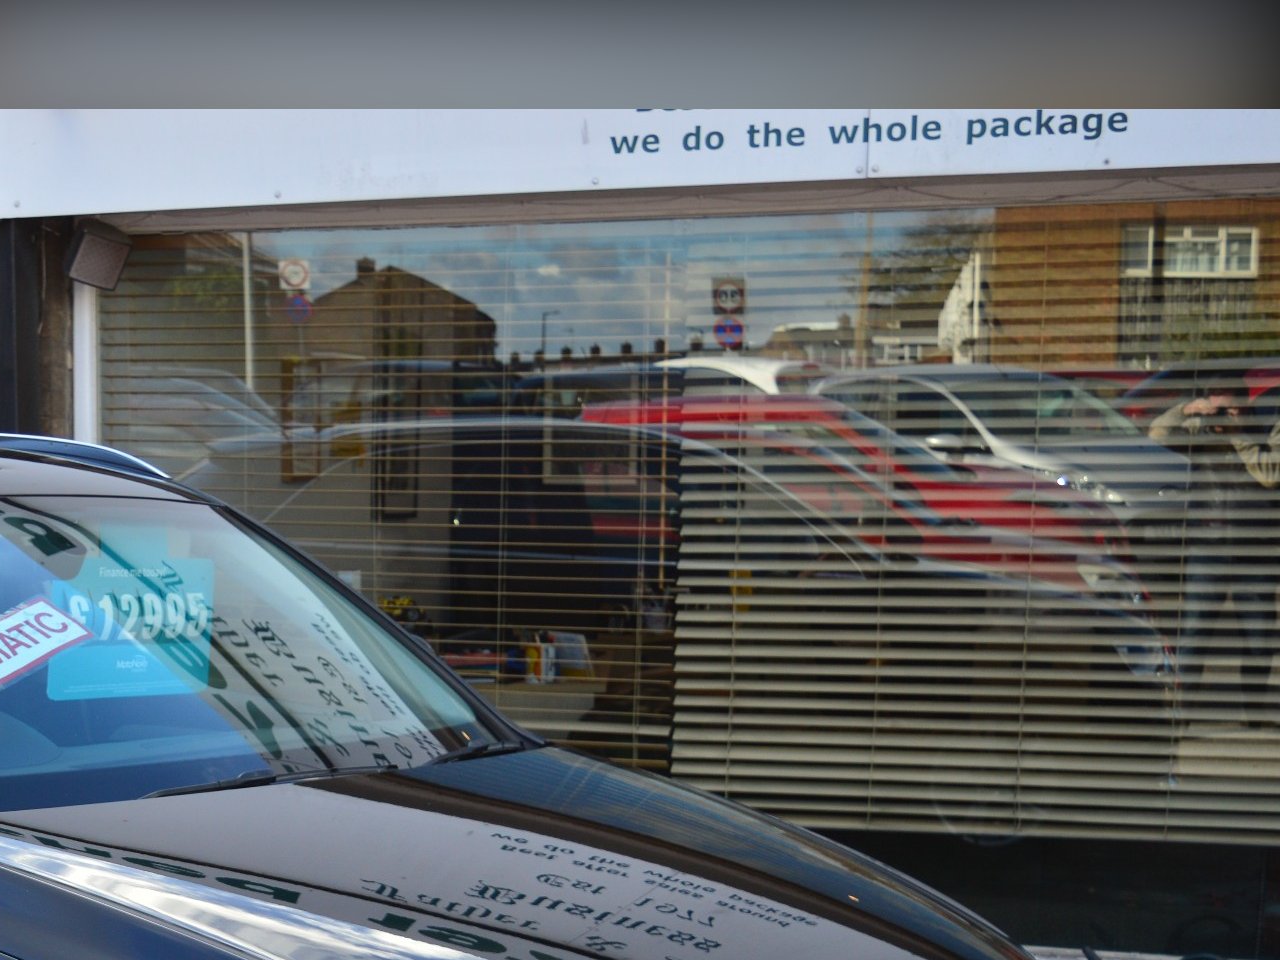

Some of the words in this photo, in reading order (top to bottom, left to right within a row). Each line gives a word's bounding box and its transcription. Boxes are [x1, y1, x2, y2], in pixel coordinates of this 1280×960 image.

[610, 133, 660, 154] we
[682, 125, 724, 151] do
[747, 122, 805, 148] the
[828, 115, 941, 144] whole
[966, 109, 1128, 145] package
[70, 592, 208, 641] £12995
